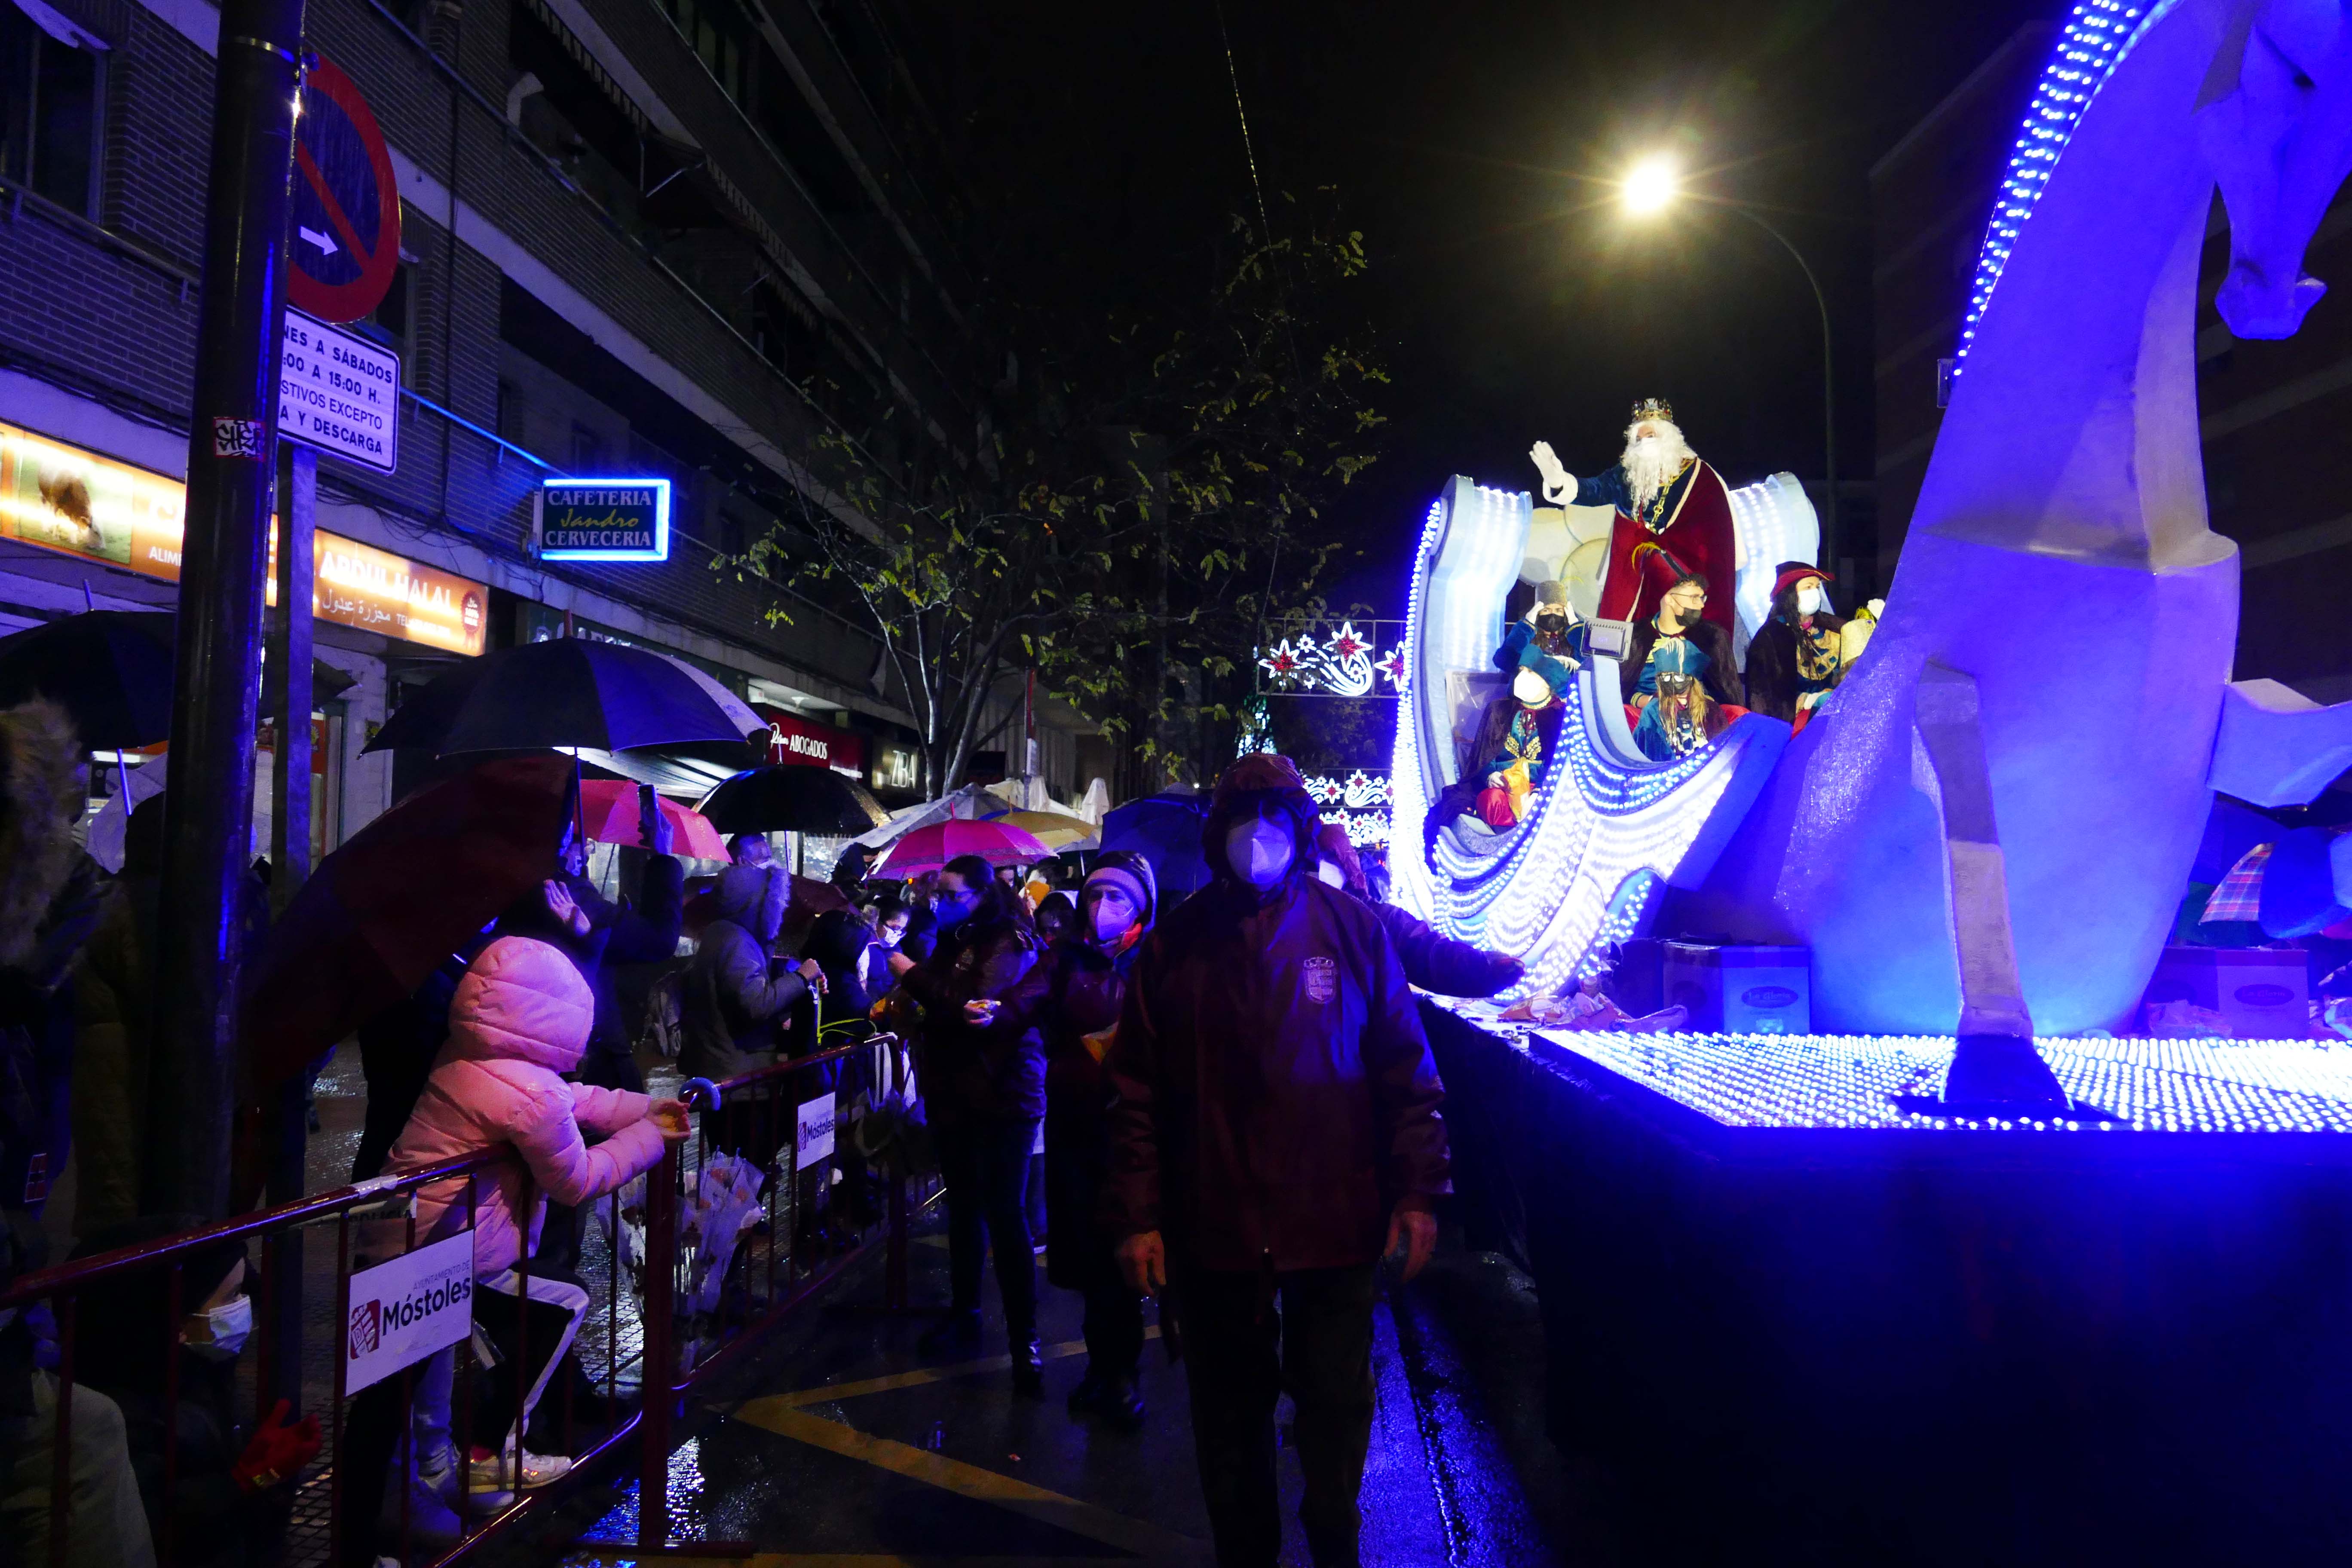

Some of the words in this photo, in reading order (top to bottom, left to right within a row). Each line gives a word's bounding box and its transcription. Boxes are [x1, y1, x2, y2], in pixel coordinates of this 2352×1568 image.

[316, 340, 324, 355] A
[333, 347, 392, 383] SÁBADOS
[283, 353, 304, 371] :00
[312, 365, 321, 379] A
[329, 371, 361, 395] 15:00
[368, 387, 380, 404] H.
[280, 380, 325, 408] STIVOS
[330, 398, 382, 429] EXCEPTO
[281, 405, 288, 420] A
[298, 411, 306, 426] Y
[314, 417, 382, 455] DESCARGA
[548, 490, 652, 505] CAFETERIA
[560, 508, 639, 528] Jandro
[545, 530, 651, 546] CERVECERIA
[789, 734, 828, 760] ABOGADOS
[807, 1118, 834, 1142] Móstoles
[413, 1265, 461, 1289] AYUNTAMIENTO
[462, 1260, 470, 1271] DE
[382, 1277, 471, 1336] Móstoles
